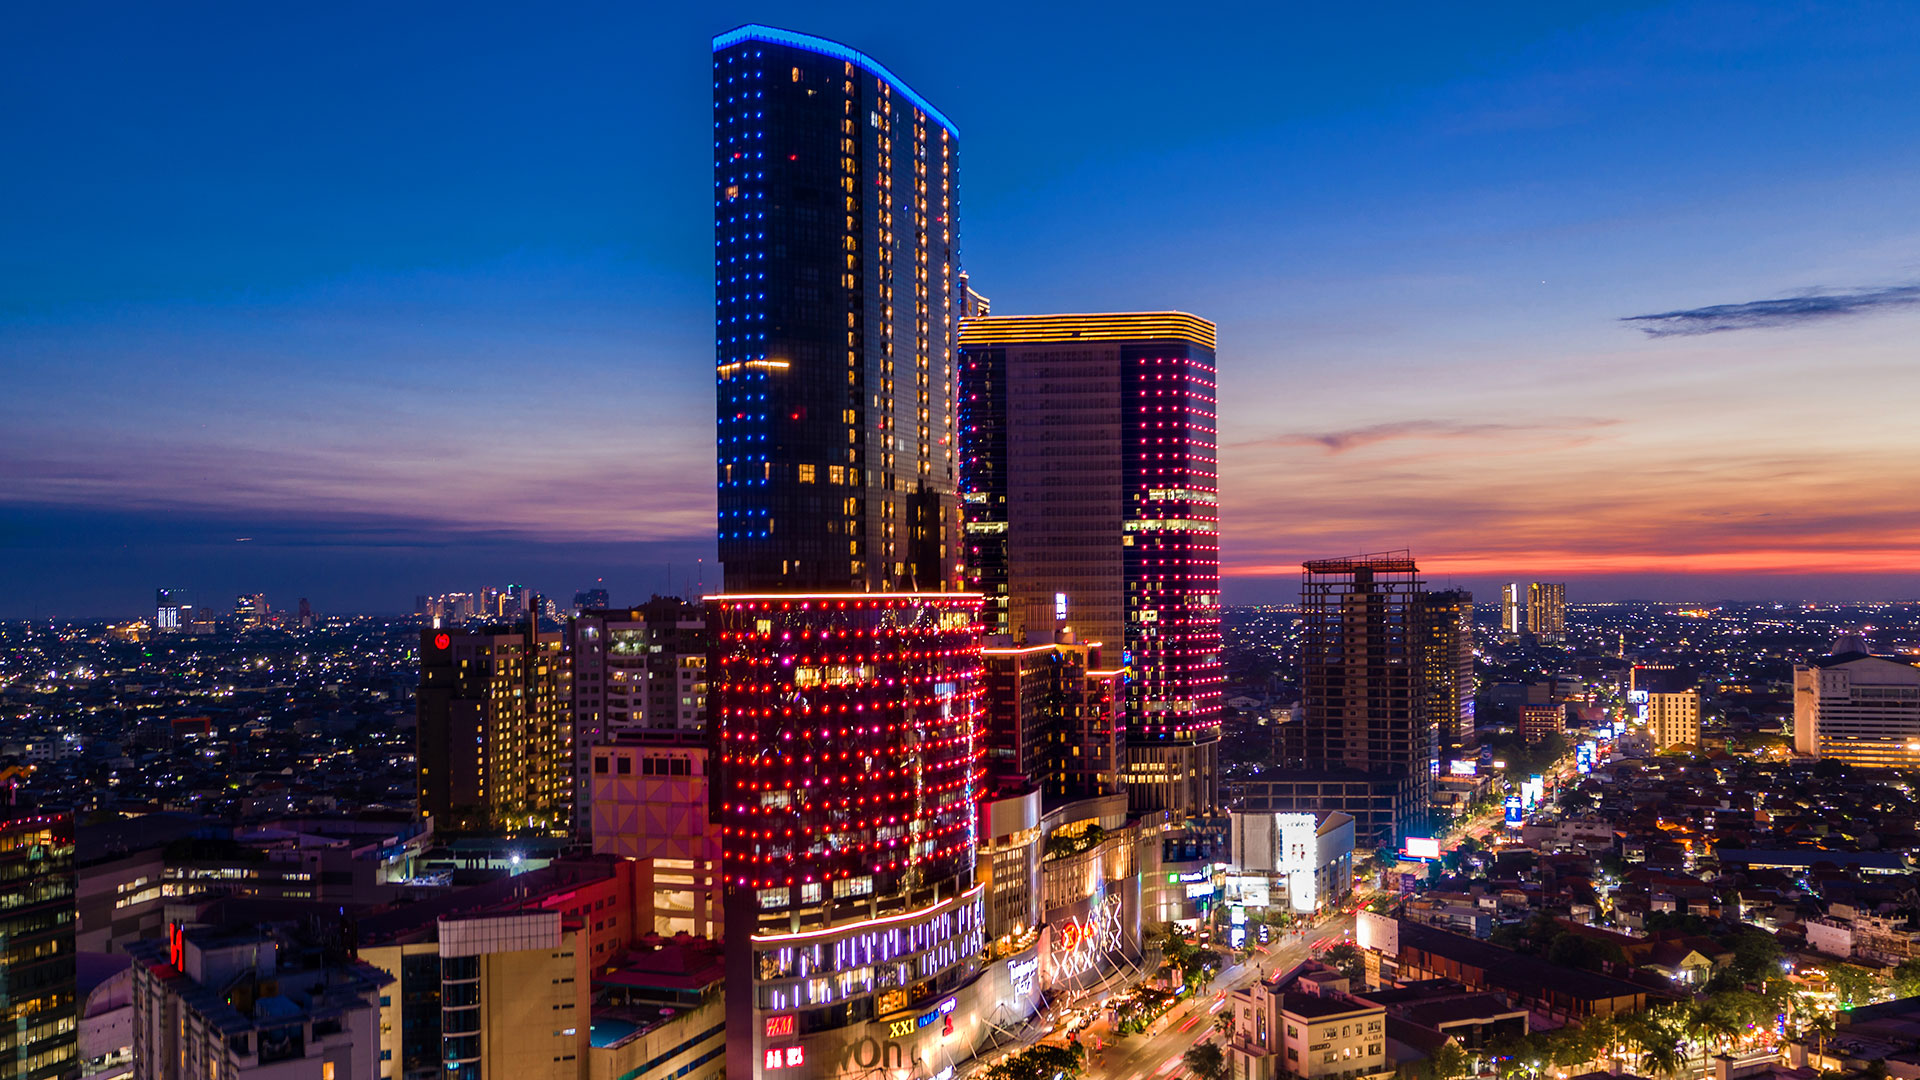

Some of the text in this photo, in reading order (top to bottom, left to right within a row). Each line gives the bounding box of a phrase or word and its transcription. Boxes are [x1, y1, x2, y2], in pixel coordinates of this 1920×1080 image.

[889, 1018, 916, 1039] XXI
[918, 1008, 940, 1029] IMAX
[1363, 1034, 1384, 1042] ALBA
